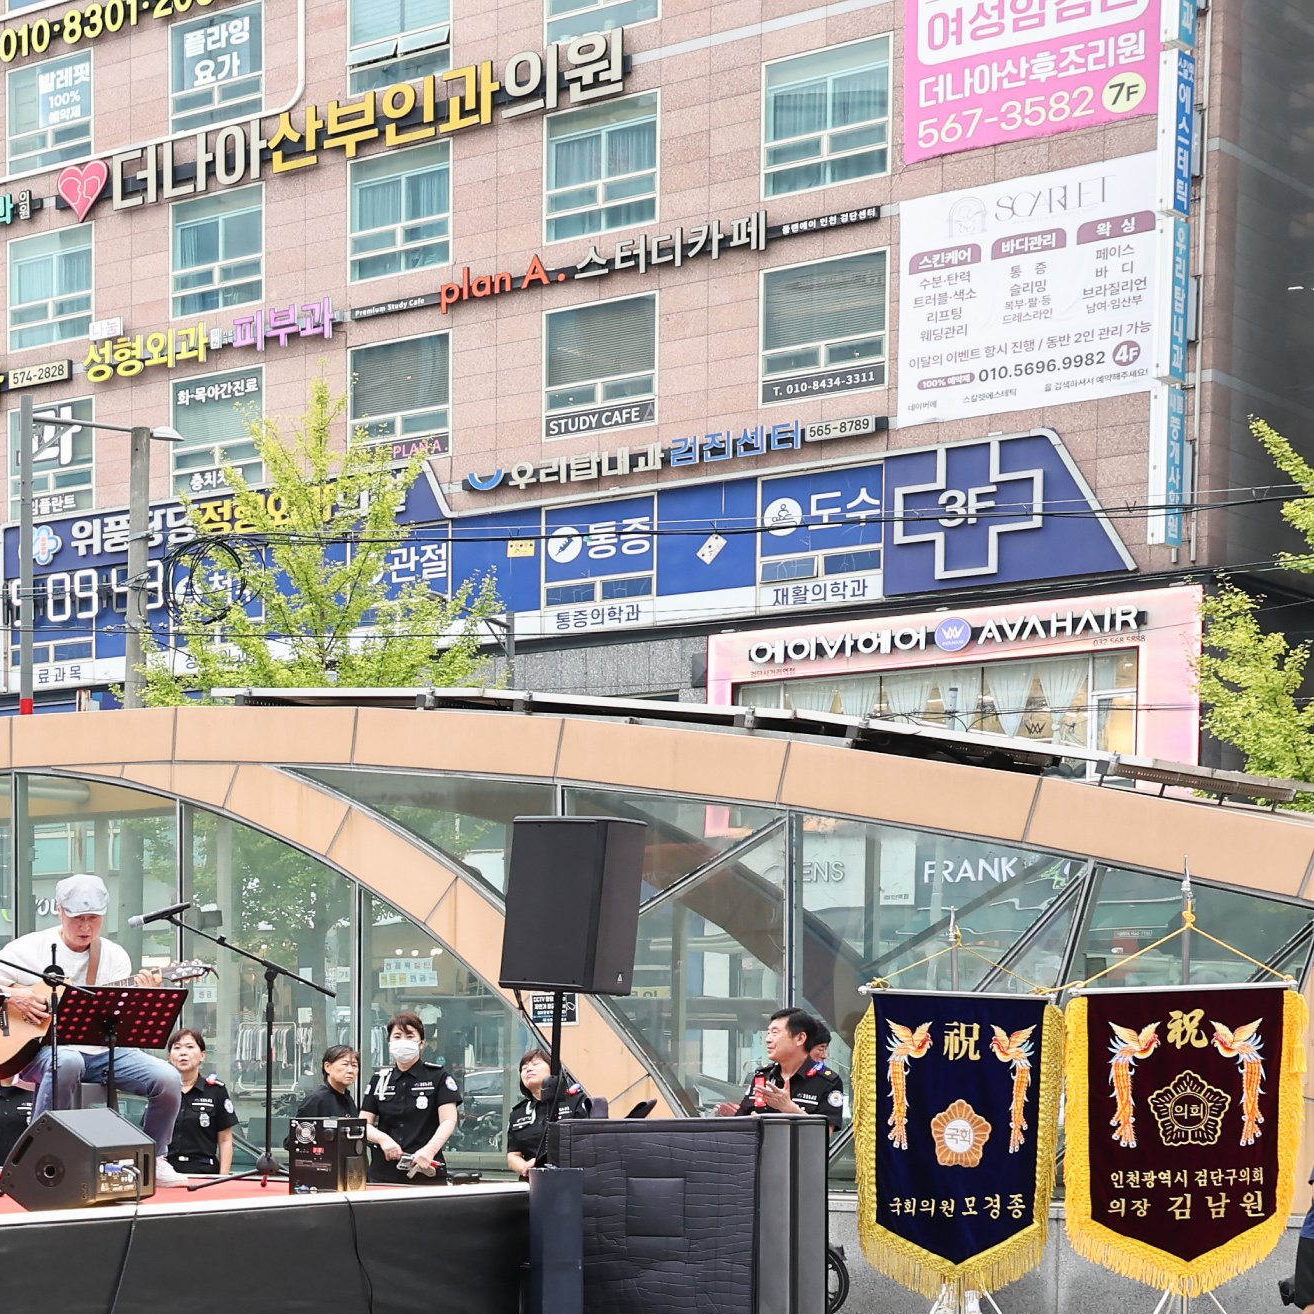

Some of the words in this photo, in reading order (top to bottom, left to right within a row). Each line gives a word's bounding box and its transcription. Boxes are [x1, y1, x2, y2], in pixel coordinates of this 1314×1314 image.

[183, 15, 251, 59] 플라잉
[38, 61, 90, 95] 발레핏
[193, 55, 241, 88] 요가
[918, 29, 1146, 109] 더나아산후조리원
[48, 89, 82, 108] 100%
[112, 27, 626, 212] 더나아산부인과의원
[918, 86, 1095, 149] 567-3582
[1108, 82, 1140, 106] 7F
[918, 247, 972, 270] 스킨케어
[1001, 232, 1056, 255] 바디관리
[1095, 243, 1135, 260] 페이스
[355, 304, 386, 318] Premium
[387, 300, 408, 313] Study
[409, 296, 426, 309] Cafe
[440, 266, 513, 315] plan
[575, 209, 769, 280] 스터디카페
[820, 212, 838, 229] 인천
[1009, 279, 1047, 297] 슬리밍
[1082, 276, 1148, 300] 브라질리언
[926, 306, 963, 324] 리프팅
[1001, 307, 1054, 326] 드레스라인
[83, 320, 210, 384] 성형외과
[232, 303, 337, 352] 피부과
[908, 351, 943, 369] 이달의
[946, 344, 982, 364] 이벤트
[984, 340, 1009, 358] 항시
[1011, 336, 1036, 354] 진행
[1046, 331, 1071, 349] 동반
[1073, 327, 1095, 344] 2인
[1097, 323, 1123, 341] 관리
[1125, 319, 1152, 337] 가능
[919, 323, 969, 342] 웨딩관리
[13, 364, 66, 385] 574-2828
[978, 350, 1107, 383] 010.5696.9982
[1113, 343, 1140, 363] 4F
[176, 376, 259, 406] 화·목야간진료
[785, 371, 876, 396] 010-8434-3311
[548, 413, 599, 436] STUDY
[601, 406, 641, 426] CAFE
[508, 442, 665, 491] 우리탑내과
[669, 419, 802, 468] 검진센터
[808, 416, 871, 439] 565-8789
[807, 486, 881, 532] 도수
[937, 484, 998, 528] 3F
[585, 515, 653, 561] 통증
[389, 543, 448, 585] 관절
[772, 578, 869, 608] 재활의학과
[555, 604, 641, 632] 통증의학과
[977, 605, 1139, 646] AVAHAIR
[750, 625, 927, 665] 에이바헤어
[923, 856, 1019, 885] FRANK
[942, 1020, 982, 1062] 祝
[1166, 1007, 1211, 1050] 祝
[1173, 1102, 1205, 1121] 의회
[945, 1127, 972, 1145] 국회
[1110, 1169, 1189, 1189] 인천광역시
[1194, 1167, 1265, 1188] 검단구의회
[888, 1195, 955, 1219] 국회의원
[961, 1192, 1027, 1221] 모경종
[1107, 1197, 1151, 1219] 의장
[1168, 1189, 1266, 1221] 김남원
